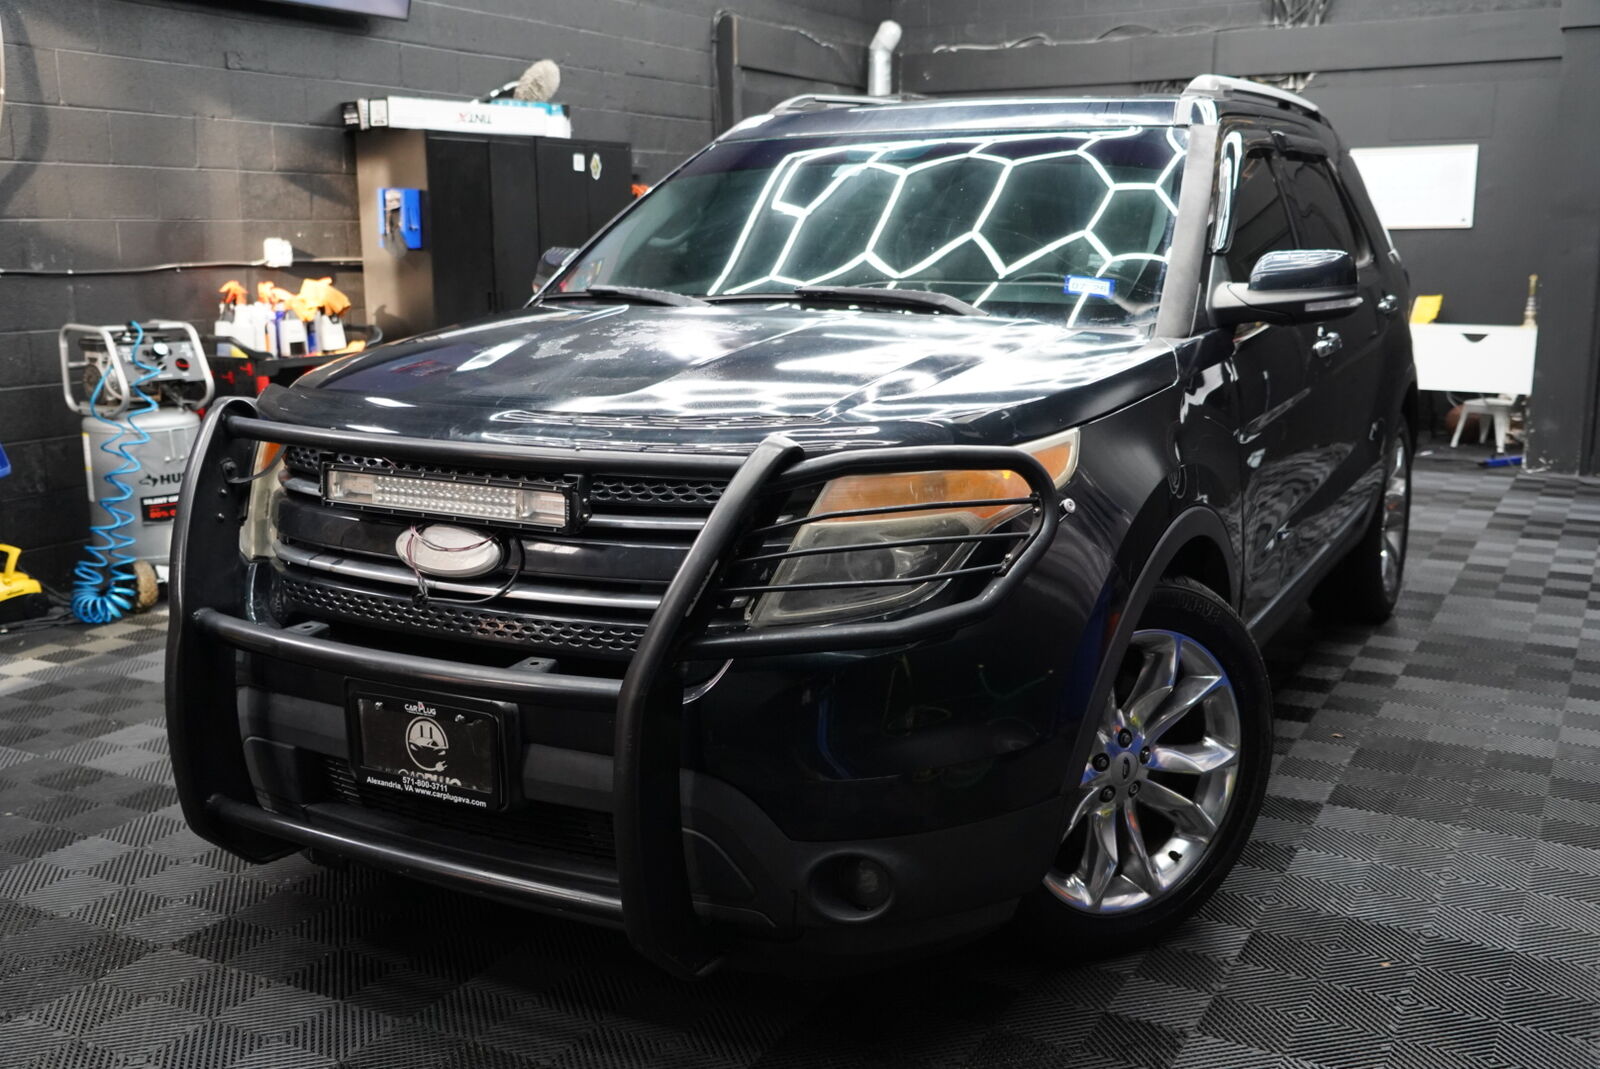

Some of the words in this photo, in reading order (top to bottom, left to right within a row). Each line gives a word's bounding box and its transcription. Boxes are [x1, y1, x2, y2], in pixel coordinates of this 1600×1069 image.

[366, 776, 403, 791] Alexandria,
[404, 784, 414, 792] VA
[415, 787, 487, 808] www.carplugava.com
[402, 776, 448, 792] 571-800-3711
